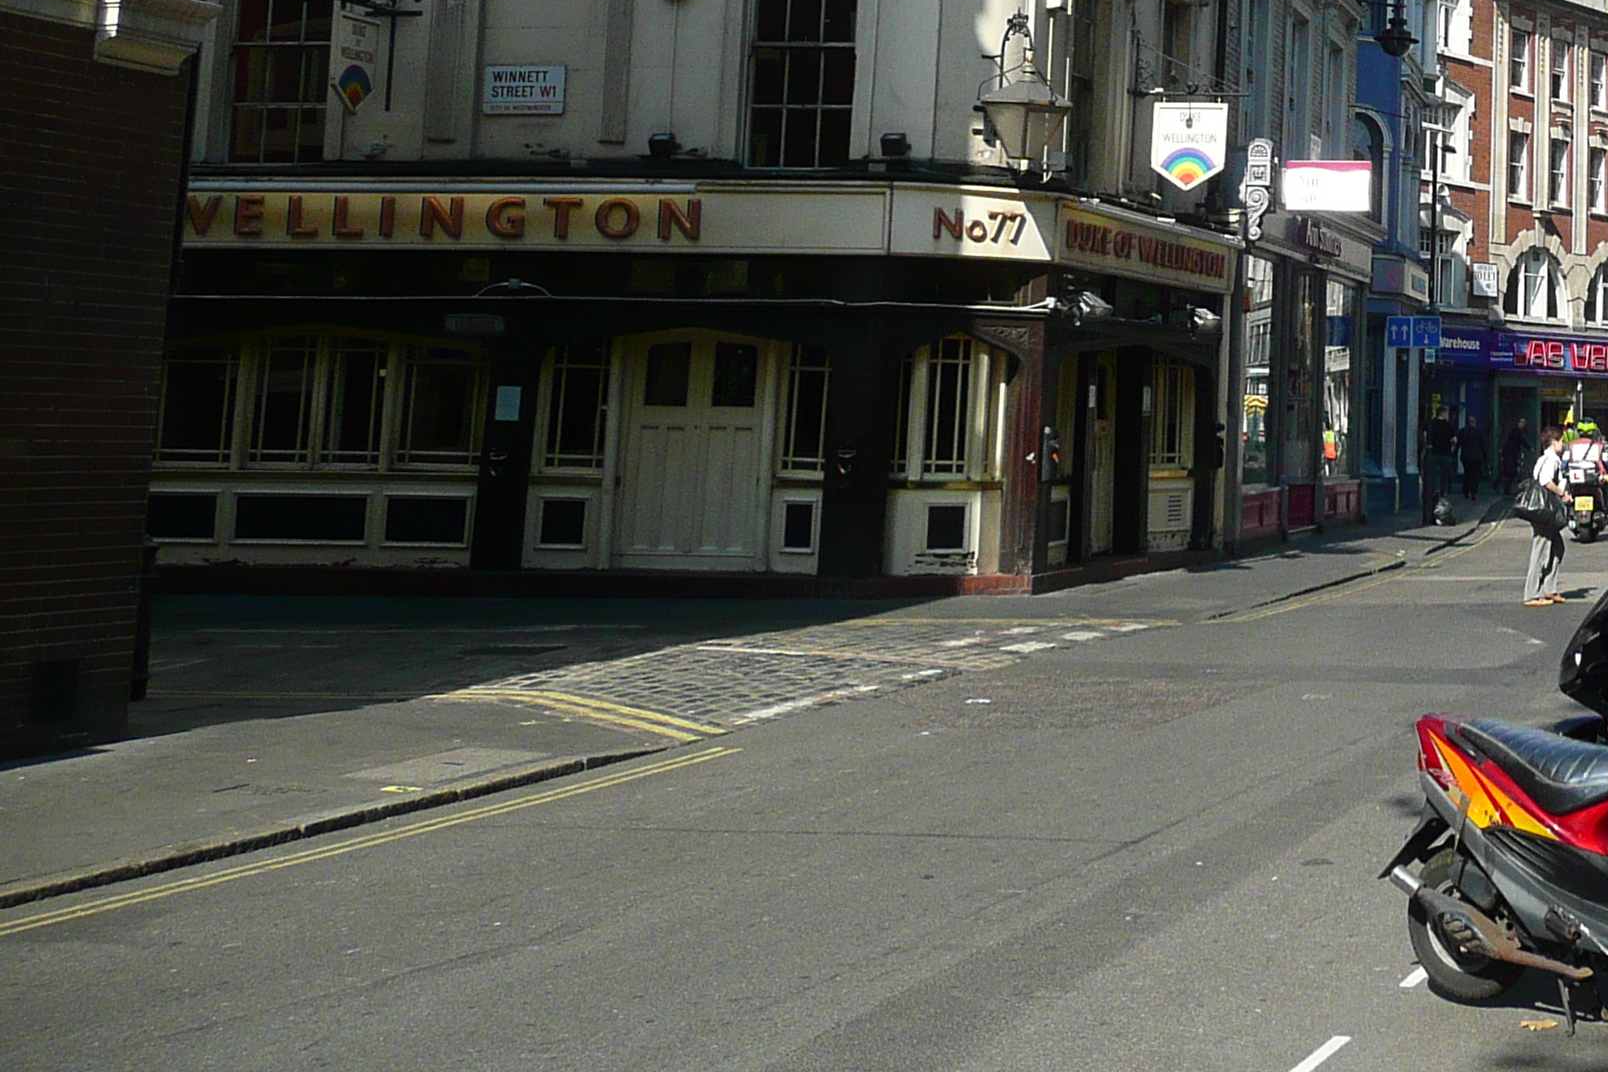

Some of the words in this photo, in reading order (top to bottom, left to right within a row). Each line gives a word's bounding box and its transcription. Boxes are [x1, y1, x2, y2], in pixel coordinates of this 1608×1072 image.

[492, 70, 549, 84] WINNETT
[491, 85, 535, 98] STREET
[539, 85, 557, 98] W1
[1163, 133, 1218, 144] WELLINGTON
[1066, 219, 1111, 256] DUKE
[1115, 229, 1137, 260] OF
[1139, 236, 1226, 280] WELLINGTON
[1514, 341, 1565, 369] LAS
